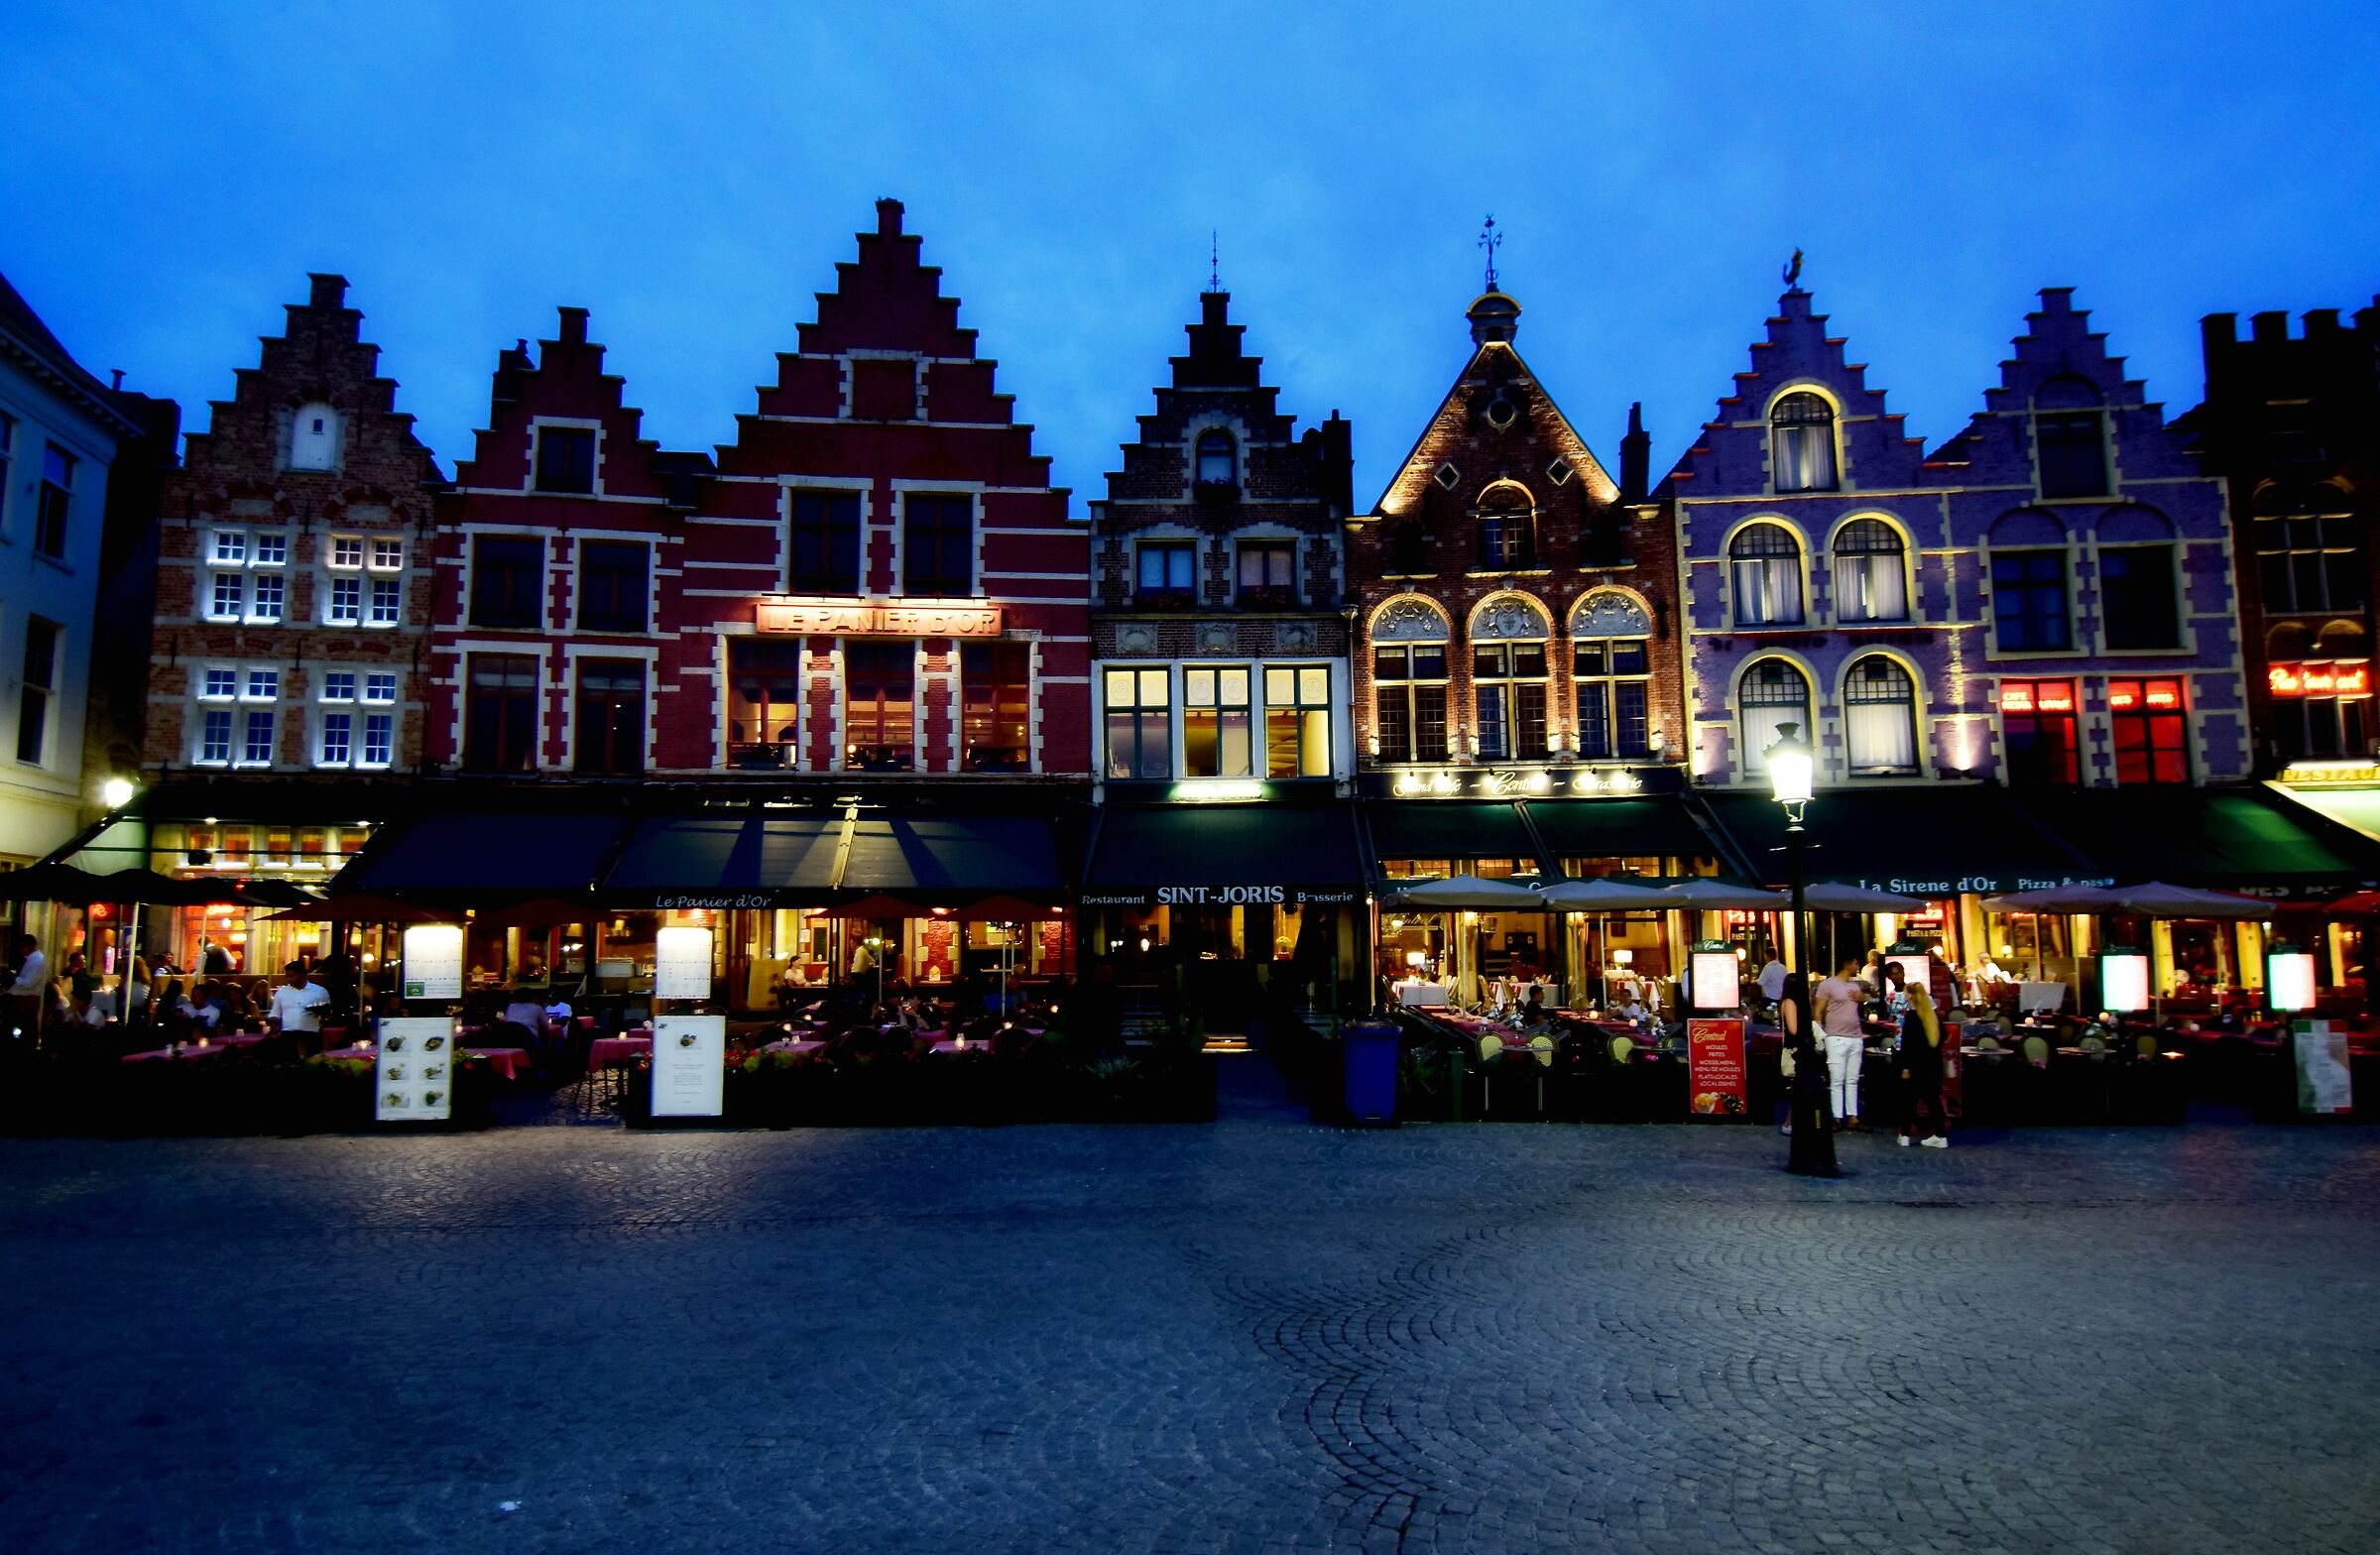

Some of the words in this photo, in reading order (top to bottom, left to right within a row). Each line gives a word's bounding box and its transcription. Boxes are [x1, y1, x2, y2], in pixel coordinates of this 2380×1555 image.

[769, 612, 805, 631] LE
[813, 609, 919, 633] PANIER
[929, 612, 996, 634] D'OR
[1491, 772, 1551, 794] Centr
[1889, 879, 1950, 893] Sirene
[1957, 877, 1997, 892] d'Or
[2018, 879, 2056, 890] Pizza
[2080, 878, 2115, 888] pas
[655, 896, 675, 907] Le
[676, 896, 733, 907] Panier
[736, 895, 772, 907] d'Or
[1082, 895, 1145, 904] Restaurant
[1156, 886, 1285, 903] SINT-JORIS
